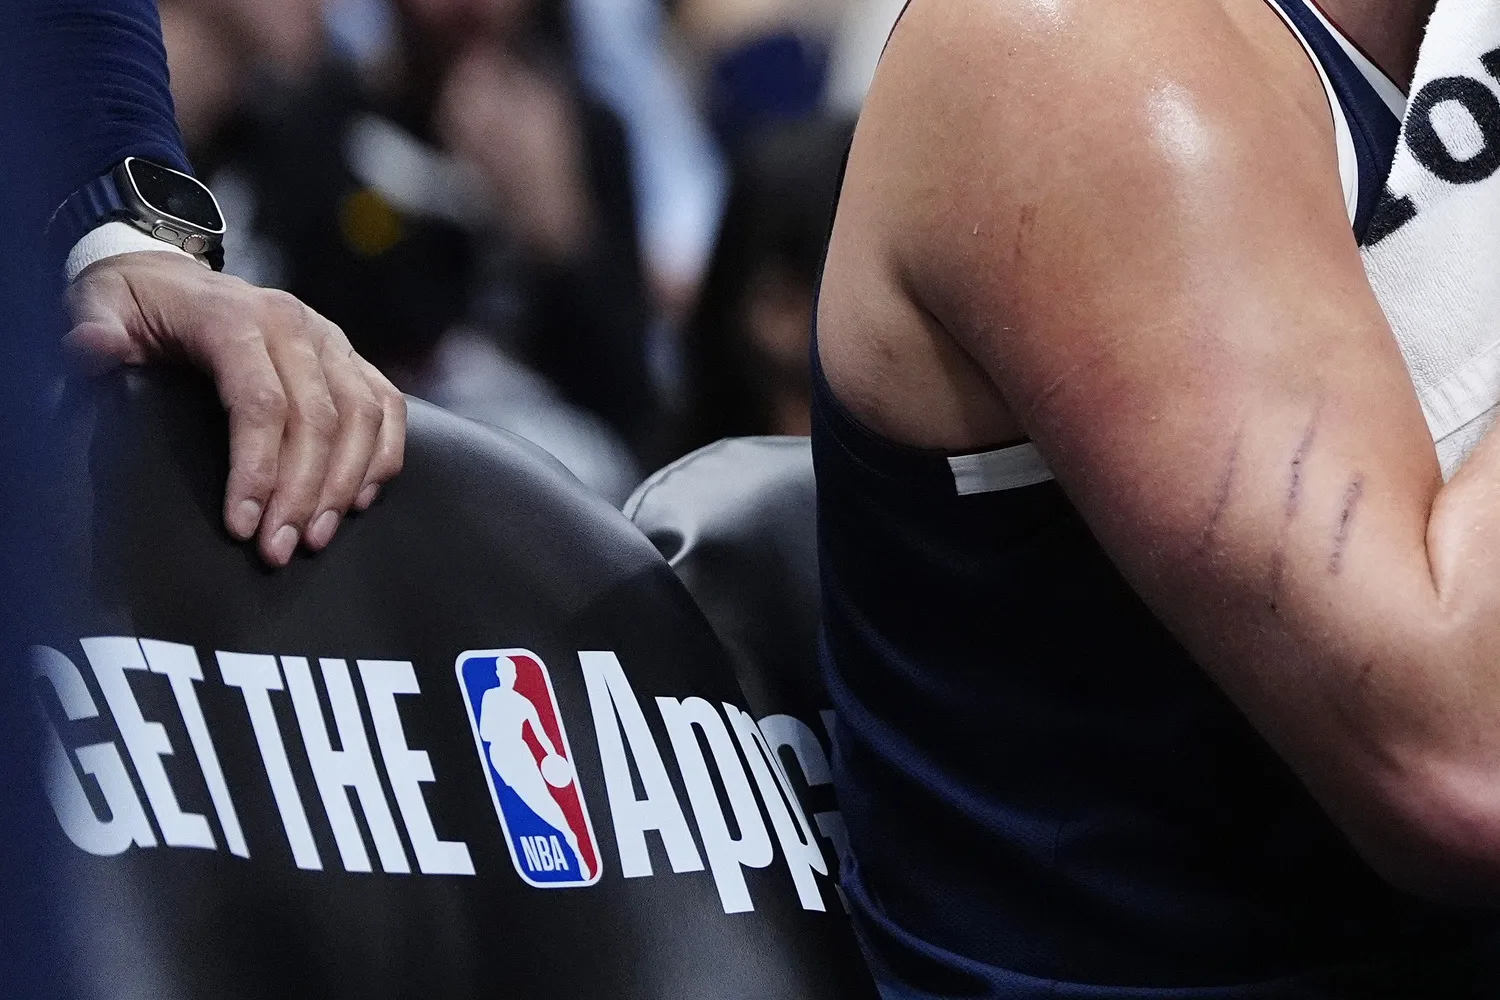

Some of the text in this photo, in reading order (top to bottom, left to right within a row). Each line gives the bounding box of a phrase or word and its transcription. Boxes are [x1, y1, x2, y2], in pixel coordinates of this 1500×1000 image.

[28, 635, 250, 859] GET
[215, 650, 477, 876] THE
[519, 834, 571, 874] NBA
[577, 649, 828, 913] App
